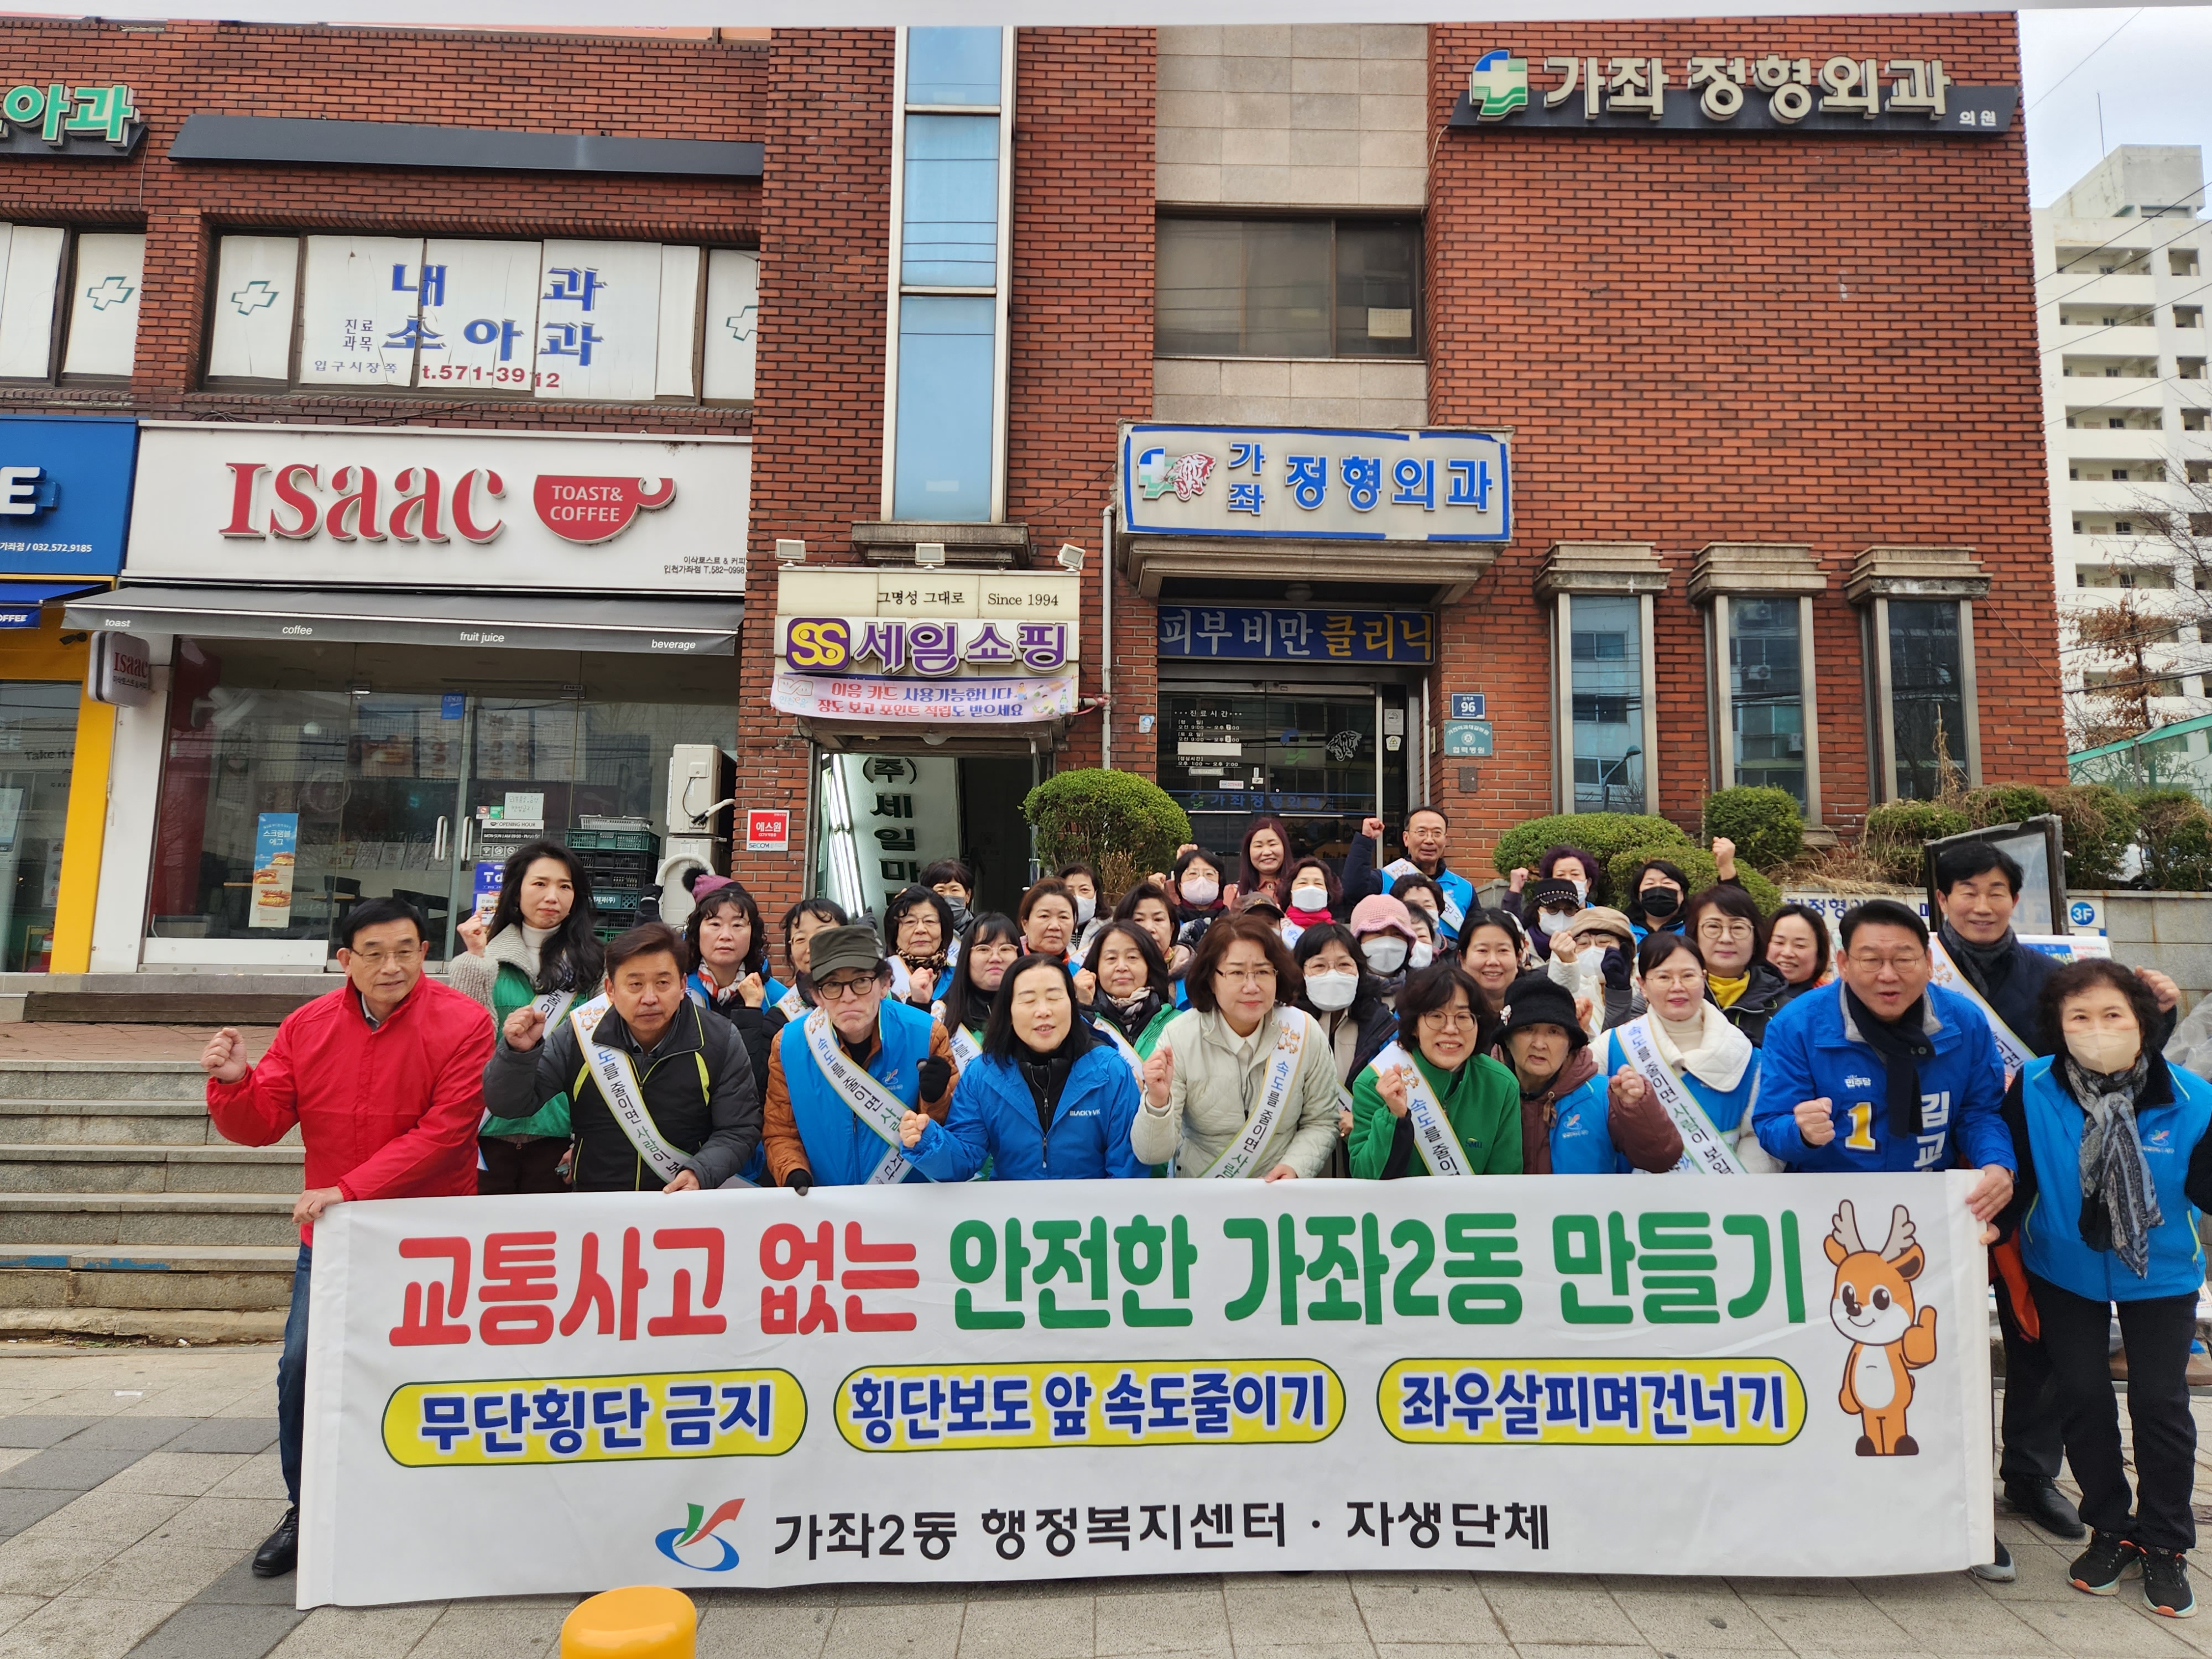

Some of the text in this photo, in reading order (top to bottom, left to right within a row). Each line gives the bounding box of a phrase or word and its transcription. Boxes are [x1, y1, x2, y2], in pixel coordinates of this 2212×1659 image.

[1543, 54, 1997, 127] 가좌 정형외과 의원
[0, 83, 138, 147] 아과
[345, 319, 374, 333] 진료
[342, 336, 373, 353] 과목
[382, 315, 604, 367] 소아과
[551, 485, 623, 502] TOAST&
[1286, 454, 1494, 513] 정형외과
[218, 462, 507, 544] Isaac
[550, 505, 620, 522] COFFEE
[0, 542, 25, 551] 가좌점
[33, 542, 92, 552] 032.572.9185
[684, 556, 721, 565] 이삭토스트
[664, 565, 701, 575] 인천가좌점
[877, 589, 1059, 607] 그명성 그대로 Since 1994
[105, 618, 131, 628] toast
[282, 624, 313, 635] coffee
[1160, 608, 1433, 660] 피부 비만 클리닉
[460, 632, 505, 644] fruit juice
[651, 639, 697, 651] beverage
[853, 622, 1068, 677] 세일쇼핑
[113, 651, 148, 679] Isaac
[831, 682, 1014, 702] 이음 카드 사용가능합니다
[817, 698, 1024, 718] 장도 보고 포인트 적립도 받으세요
[1460, 701, 1477, 713] 96
[755, 821, 781, 832] 에스원
[2072, 907, 2093, 921] 3F
[842, 1075, 884, 1112] 줄이면
[610, 1081, 642, 1125] 줄이면
[635, 1126, 671, 1162] 사람이
[1243, 1108, 1272, 1154] 줄이면
[1673, 1103, 1710, 1144] 사람이
[1845, 1102, 1876, 1151] 1
[388, 1209, 1806, 1347] 교통사고 없는 안전한 가좌2동 만들기
[851, 1371, 1324, 1446] 횡단보도 앞 속도줄이기
[1402, 1371, 1785, 1437] 좌우살피며건너기
[421, 1383, 773, 1455] 무단횡단 금지
[774, 1500, 1550, 1561] 가좌2동 행정복지센터 자생단체
